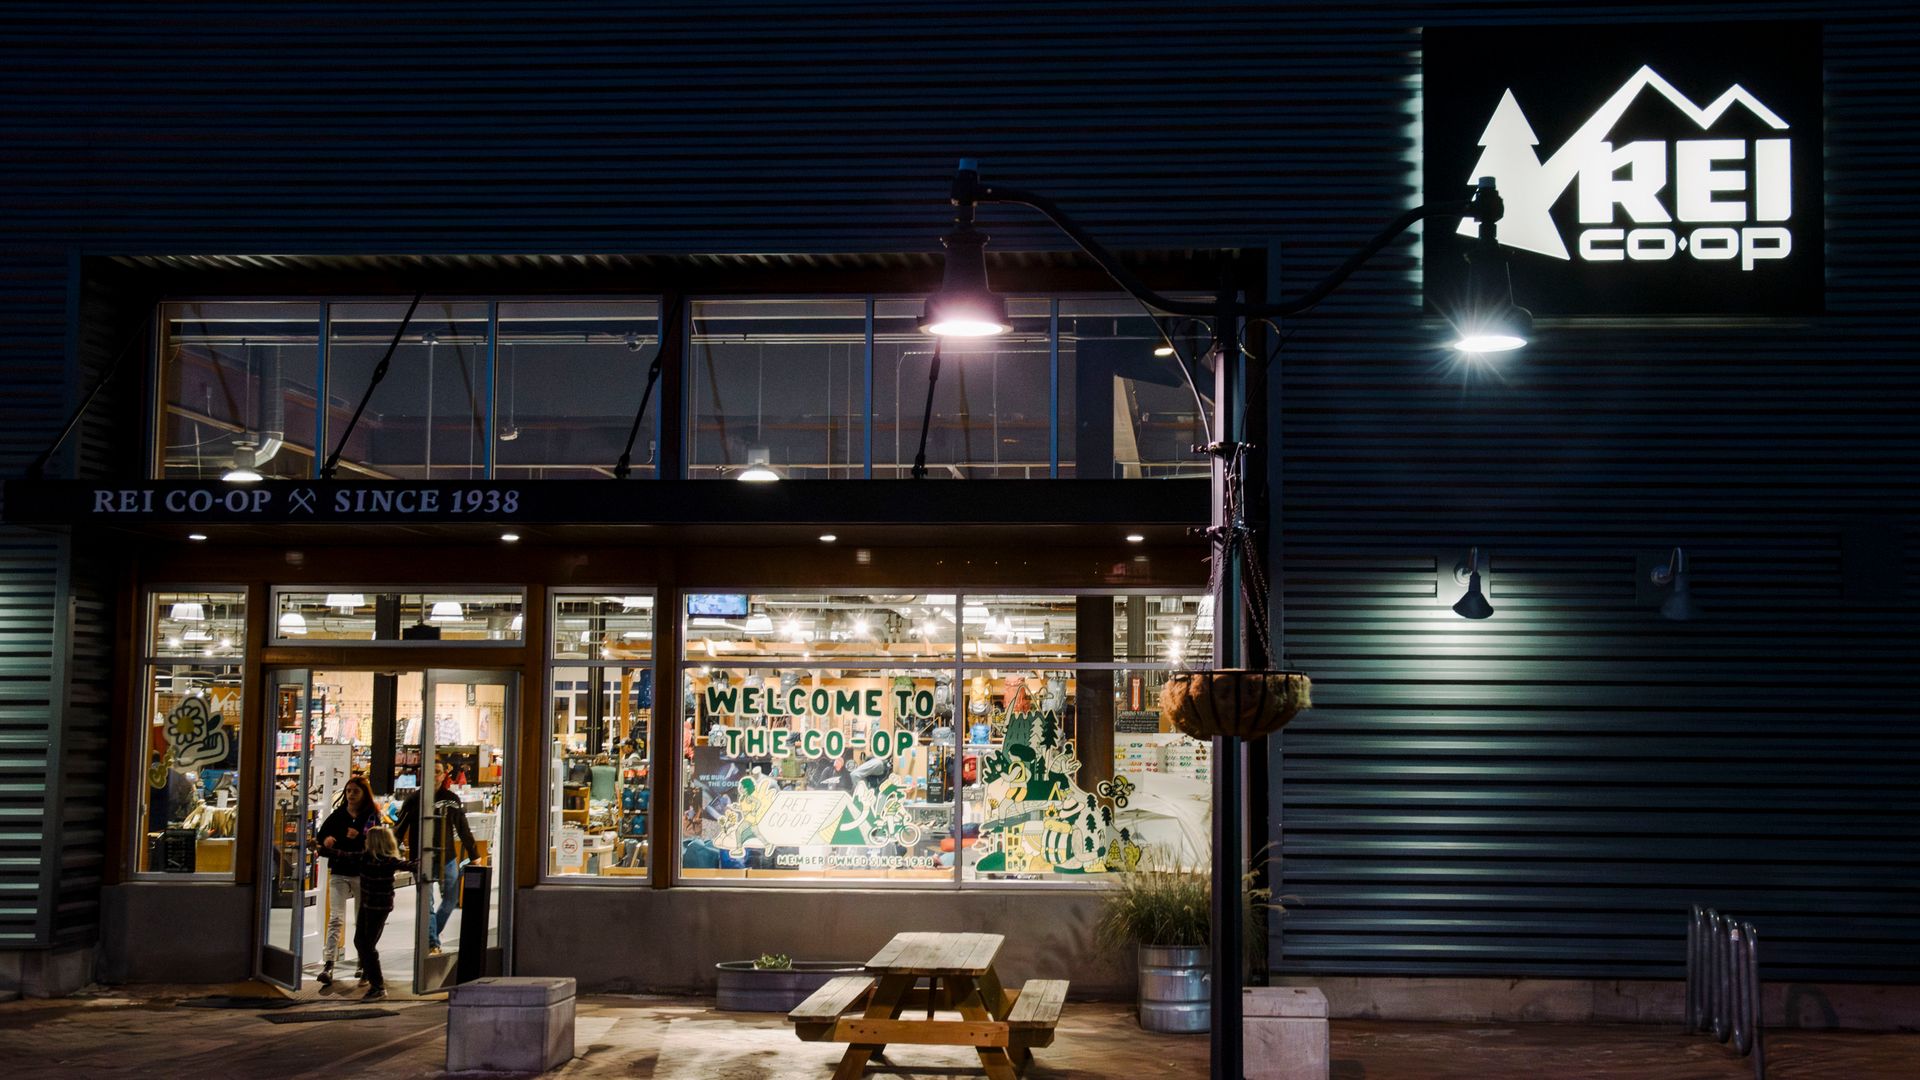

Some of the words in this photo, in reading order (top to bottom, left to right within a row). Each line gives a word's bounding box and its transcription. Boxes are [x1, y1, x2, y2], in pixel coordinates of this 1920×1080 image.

[1579, 138, 1792, 223] REI
[92, 489, 155, 513] REI
[165, 489, 272, 513] CO-OP
[334, 489, 440, 513] SINCE
[450, 489, 520, 513] 1938
[706, 686, 883, 717] WELCOME
[895, 690, 935, 718] TO
[725, 728, 789, 756] THE
[803, 729, 914, 757] CO-OP
[780, 797, 809, 812] REI
[777, 855, 825, 865] MEMBER
[828, 856, 867, 866] OWNED
[869, 856, 902, 866] SINCE
[905, 857, 934, 867] 1938
